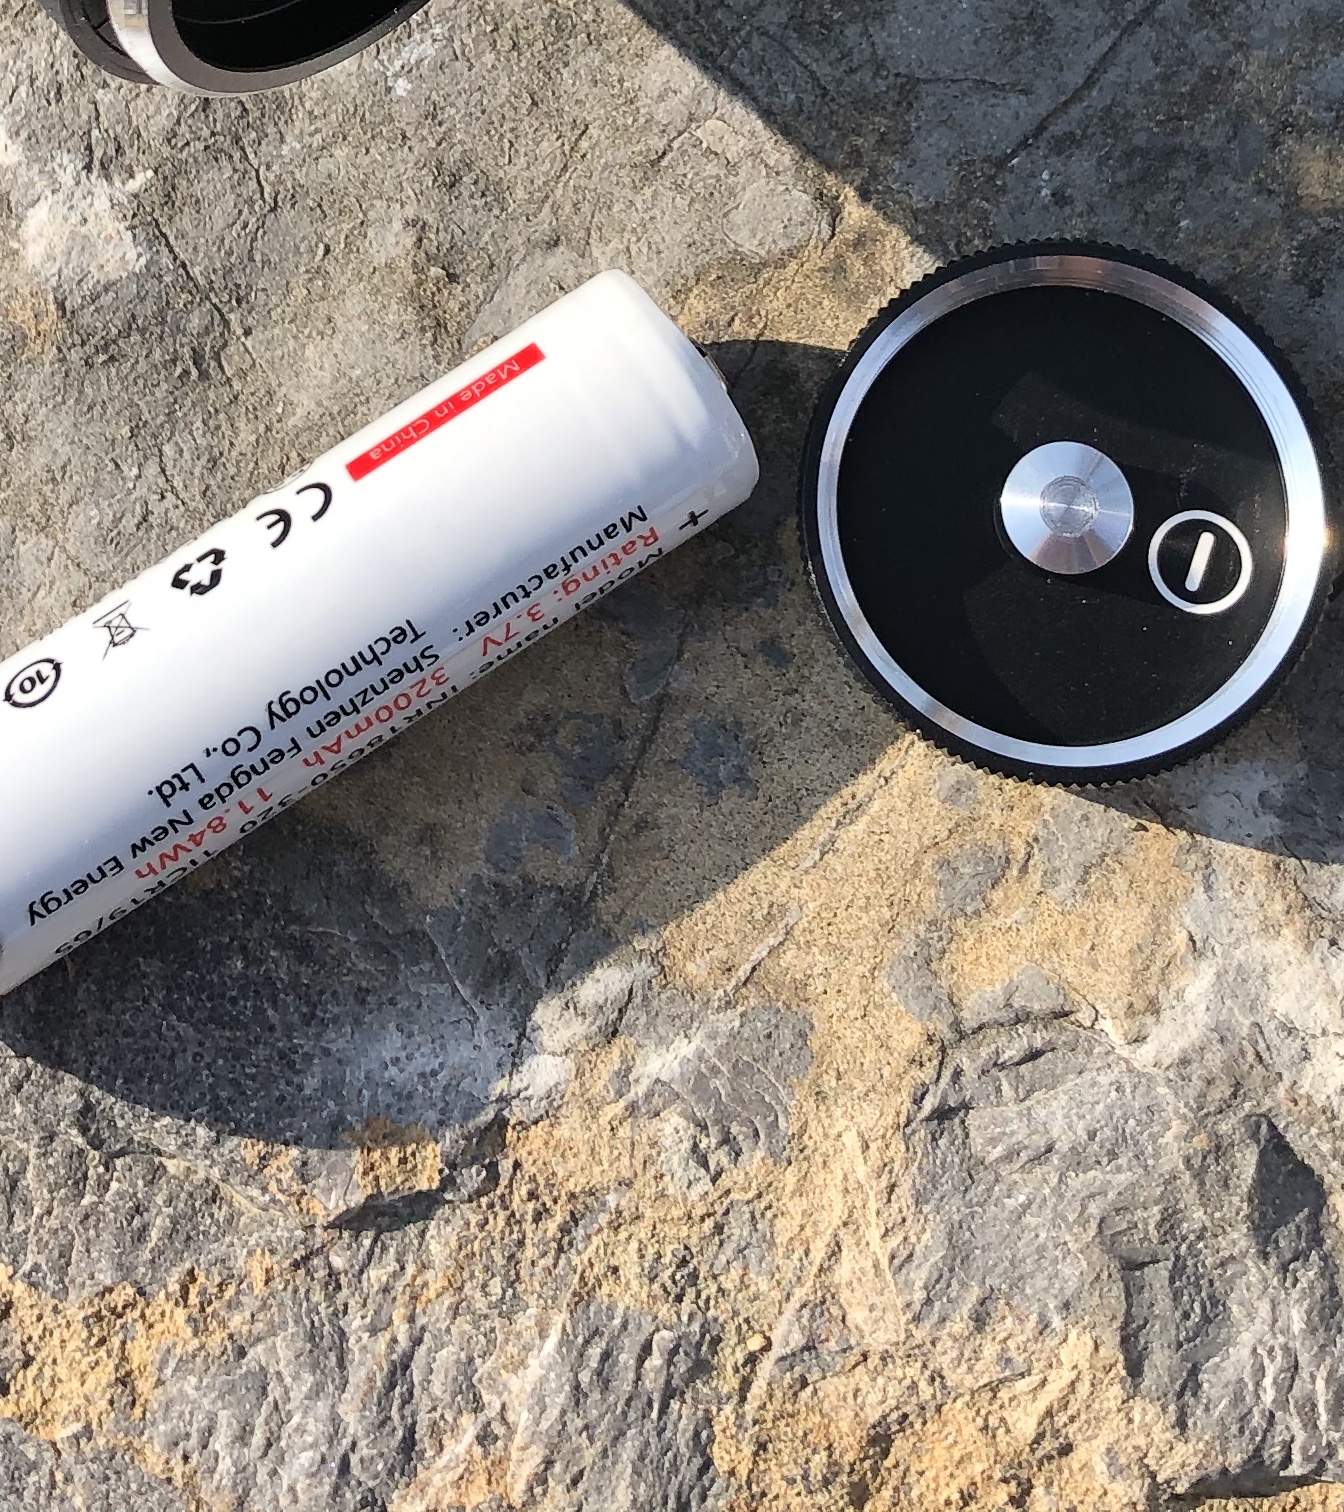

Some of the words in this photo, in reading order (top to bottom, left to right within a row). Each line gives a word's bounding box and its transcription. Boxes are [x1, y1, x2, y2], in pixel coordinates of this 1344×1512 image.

[434, 401, 457, 418] in
[459, 359, 521, 402] Made
[369, 418, 431, 460] China
[452, 504, 648, 642] Manufacturer:
[553, 526, 659, 602] Rating:
[573, 547, 664, 611] Model
[469, 616, 559, 680] name:
[481, 602, 546, 657] 3.7V
[264, 618, 427, 731] Technology
[306, 644, 441, 739] Shenzhen
[202, 725, 262, 758] Co.,
[302, 666, 450, 768] 3200mAh
[147, 762, 206, 808] Ltd.
[198, 736, 303, 810] Fengda
[130, 808, 195, 859] New
[134, 787, 273, 879] 11.84Wh
[27, 855, 125, 927] Energy
